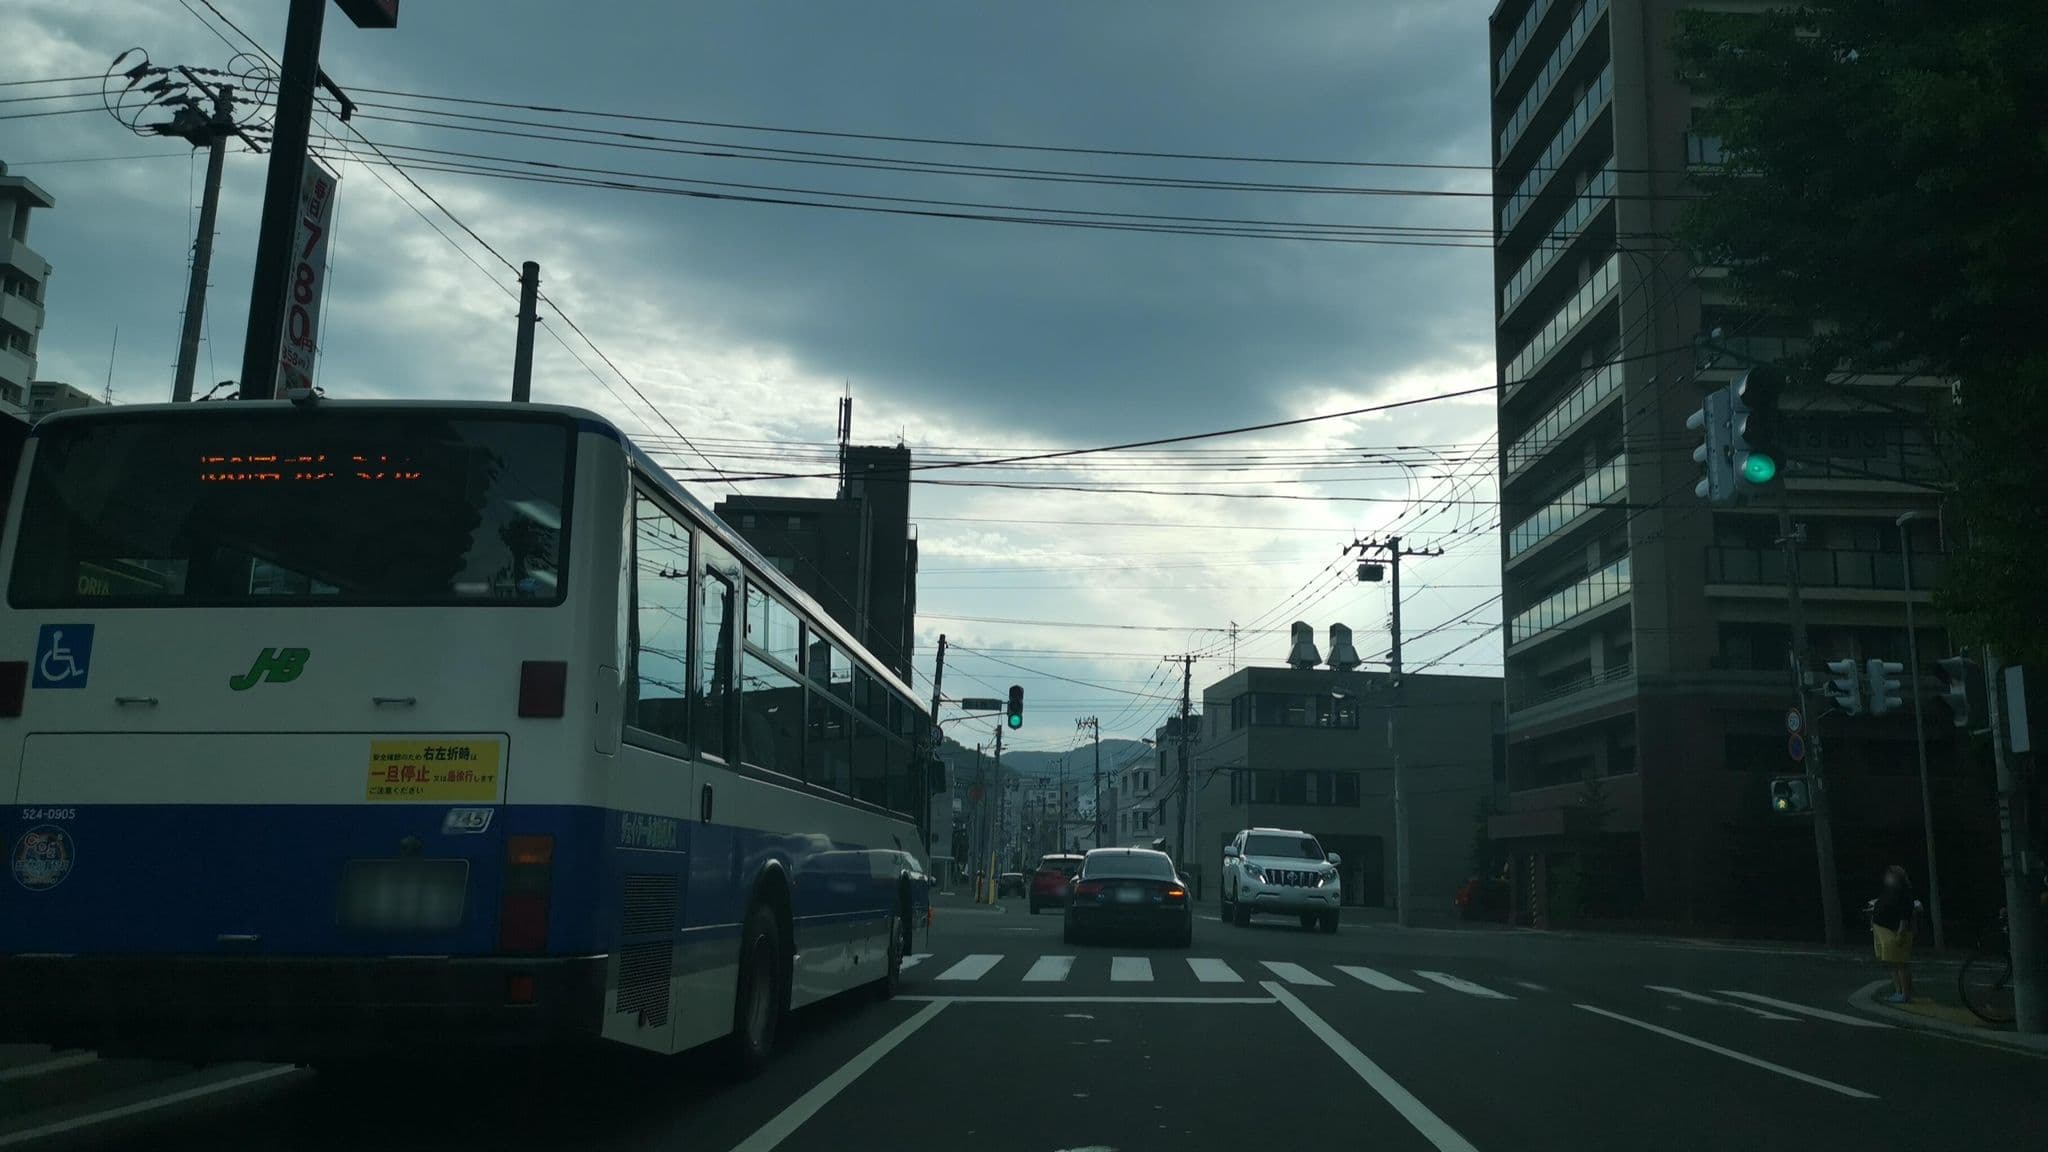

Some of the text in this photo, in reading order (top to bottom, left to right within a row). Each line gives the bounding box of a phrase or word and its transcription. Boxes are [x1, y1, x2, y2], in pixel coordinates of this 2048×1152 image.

[371, 765, 430, 783] 一旦停止
[368, 786, 424, 795] ご注意ください
[21, 807, 77, 821] 524-0905
